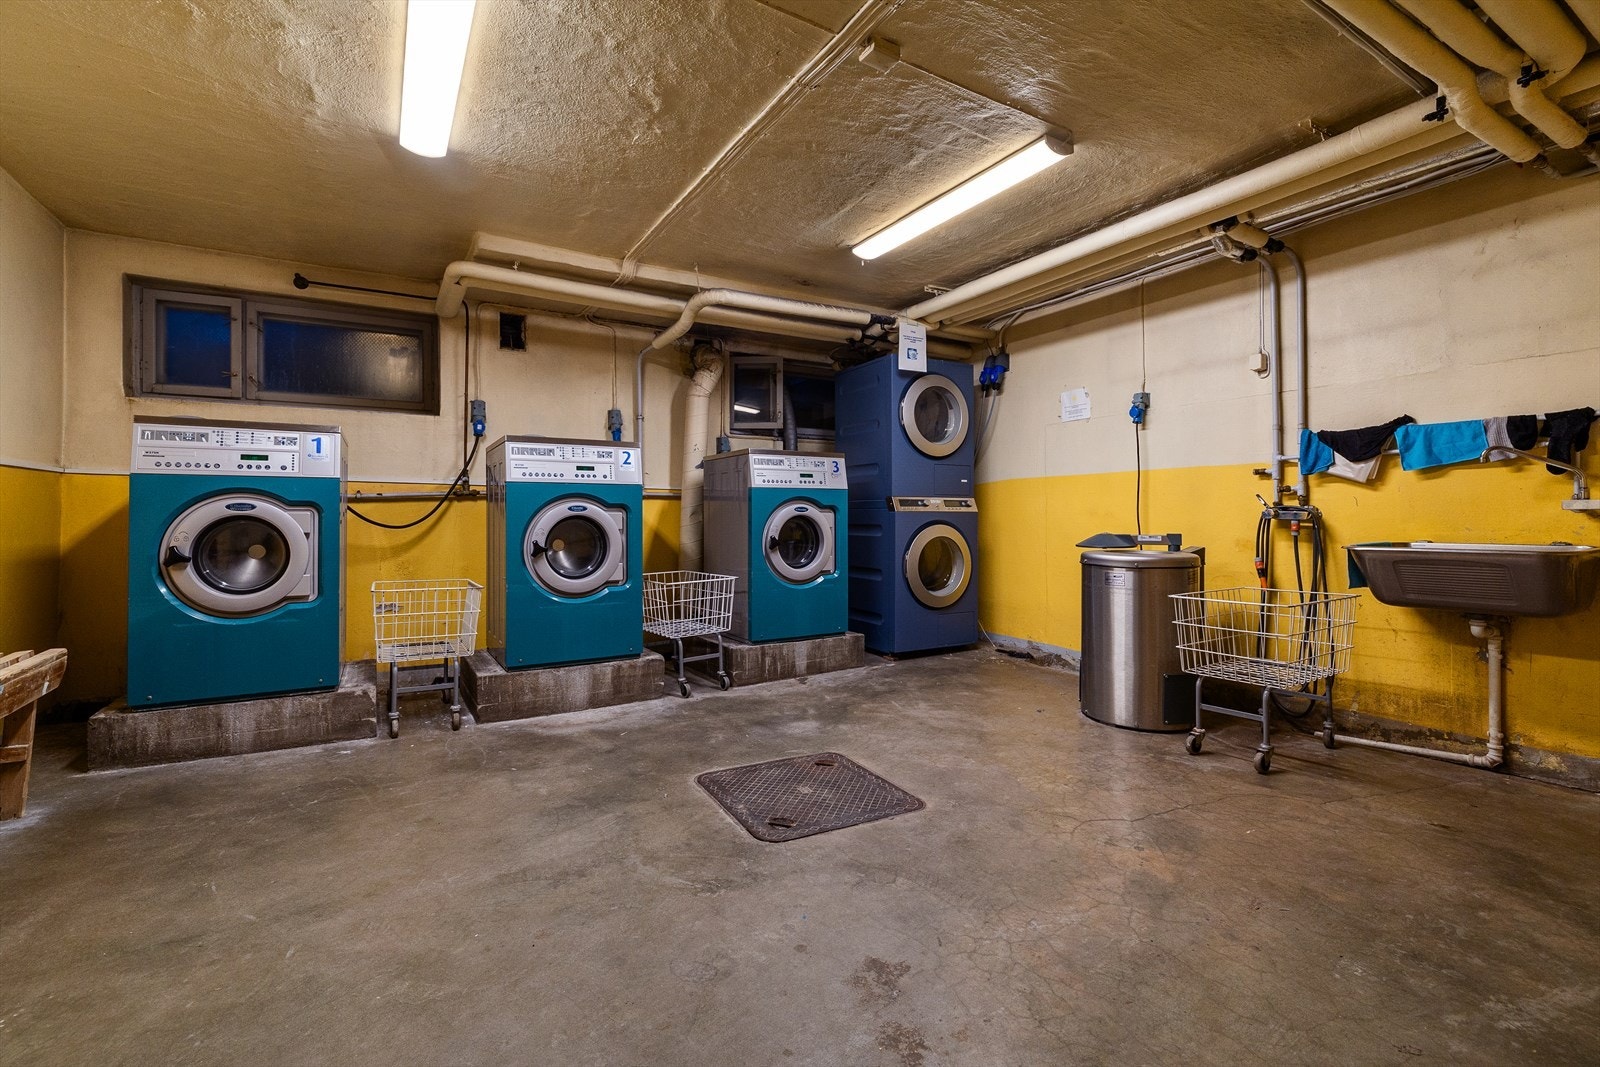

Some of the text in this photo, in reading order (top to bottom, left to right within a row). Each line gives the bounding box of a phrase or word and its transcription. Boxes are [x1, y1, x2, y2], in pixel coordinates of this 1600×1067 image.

[311, 437, 322, 454] 1
[622, 451, 632, 465] 2
[832, 461, 840, 473] 3
